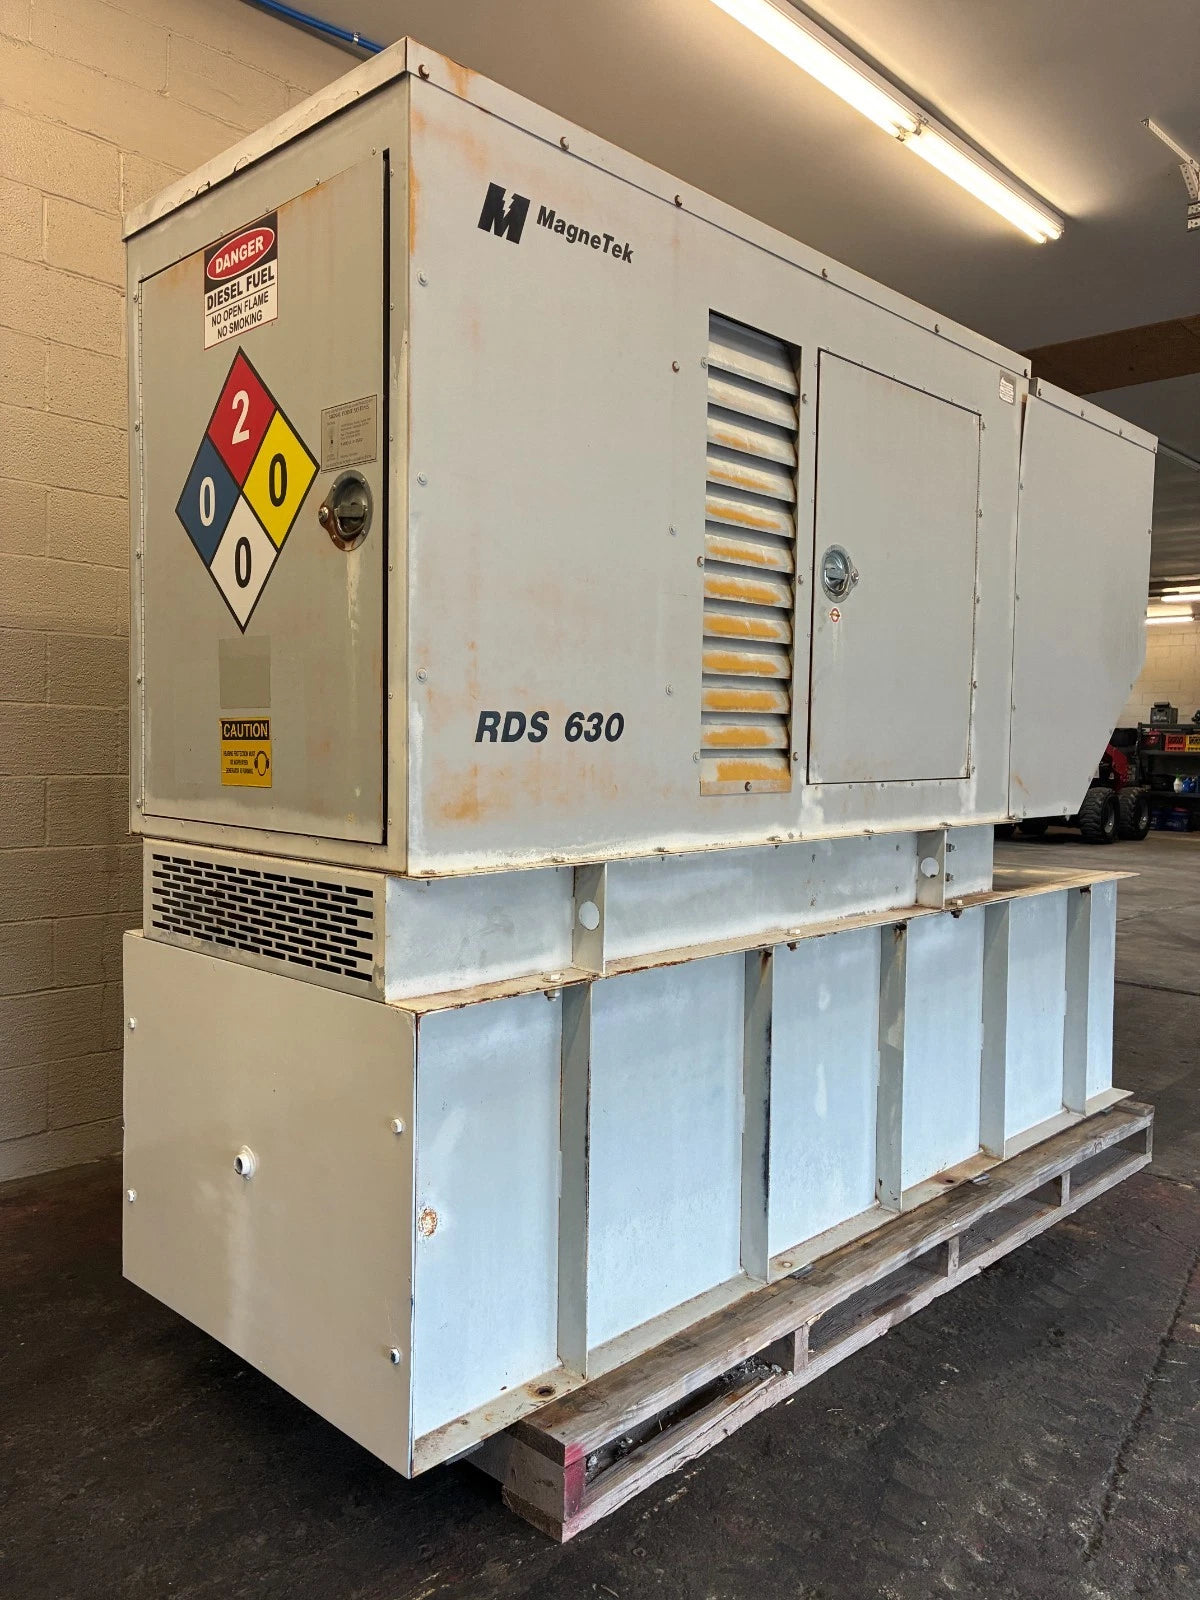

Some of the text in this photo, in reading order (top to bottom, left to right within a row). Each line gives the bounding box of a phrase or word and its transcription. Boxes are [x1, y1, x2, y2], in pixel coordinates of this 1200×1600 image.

[215, 235, 264, 274] DANGER
[536, 205, 634, 264] MagneTek
[207, 265, 275, 311] DIESEL FUEL
[211, 290, 269, 328] NO OPEN FLAME
[217, 309, 263, 340] NO SMOKING
[231, 389, 250, 445] 2
[199, 476, 216, 527] 0
[268, 452, 288, 508] 0
[234, 536, 252, 589] 0
[223, 723, 268, 738] CAUTION
[474, 710, 625, 743] RDS 630
